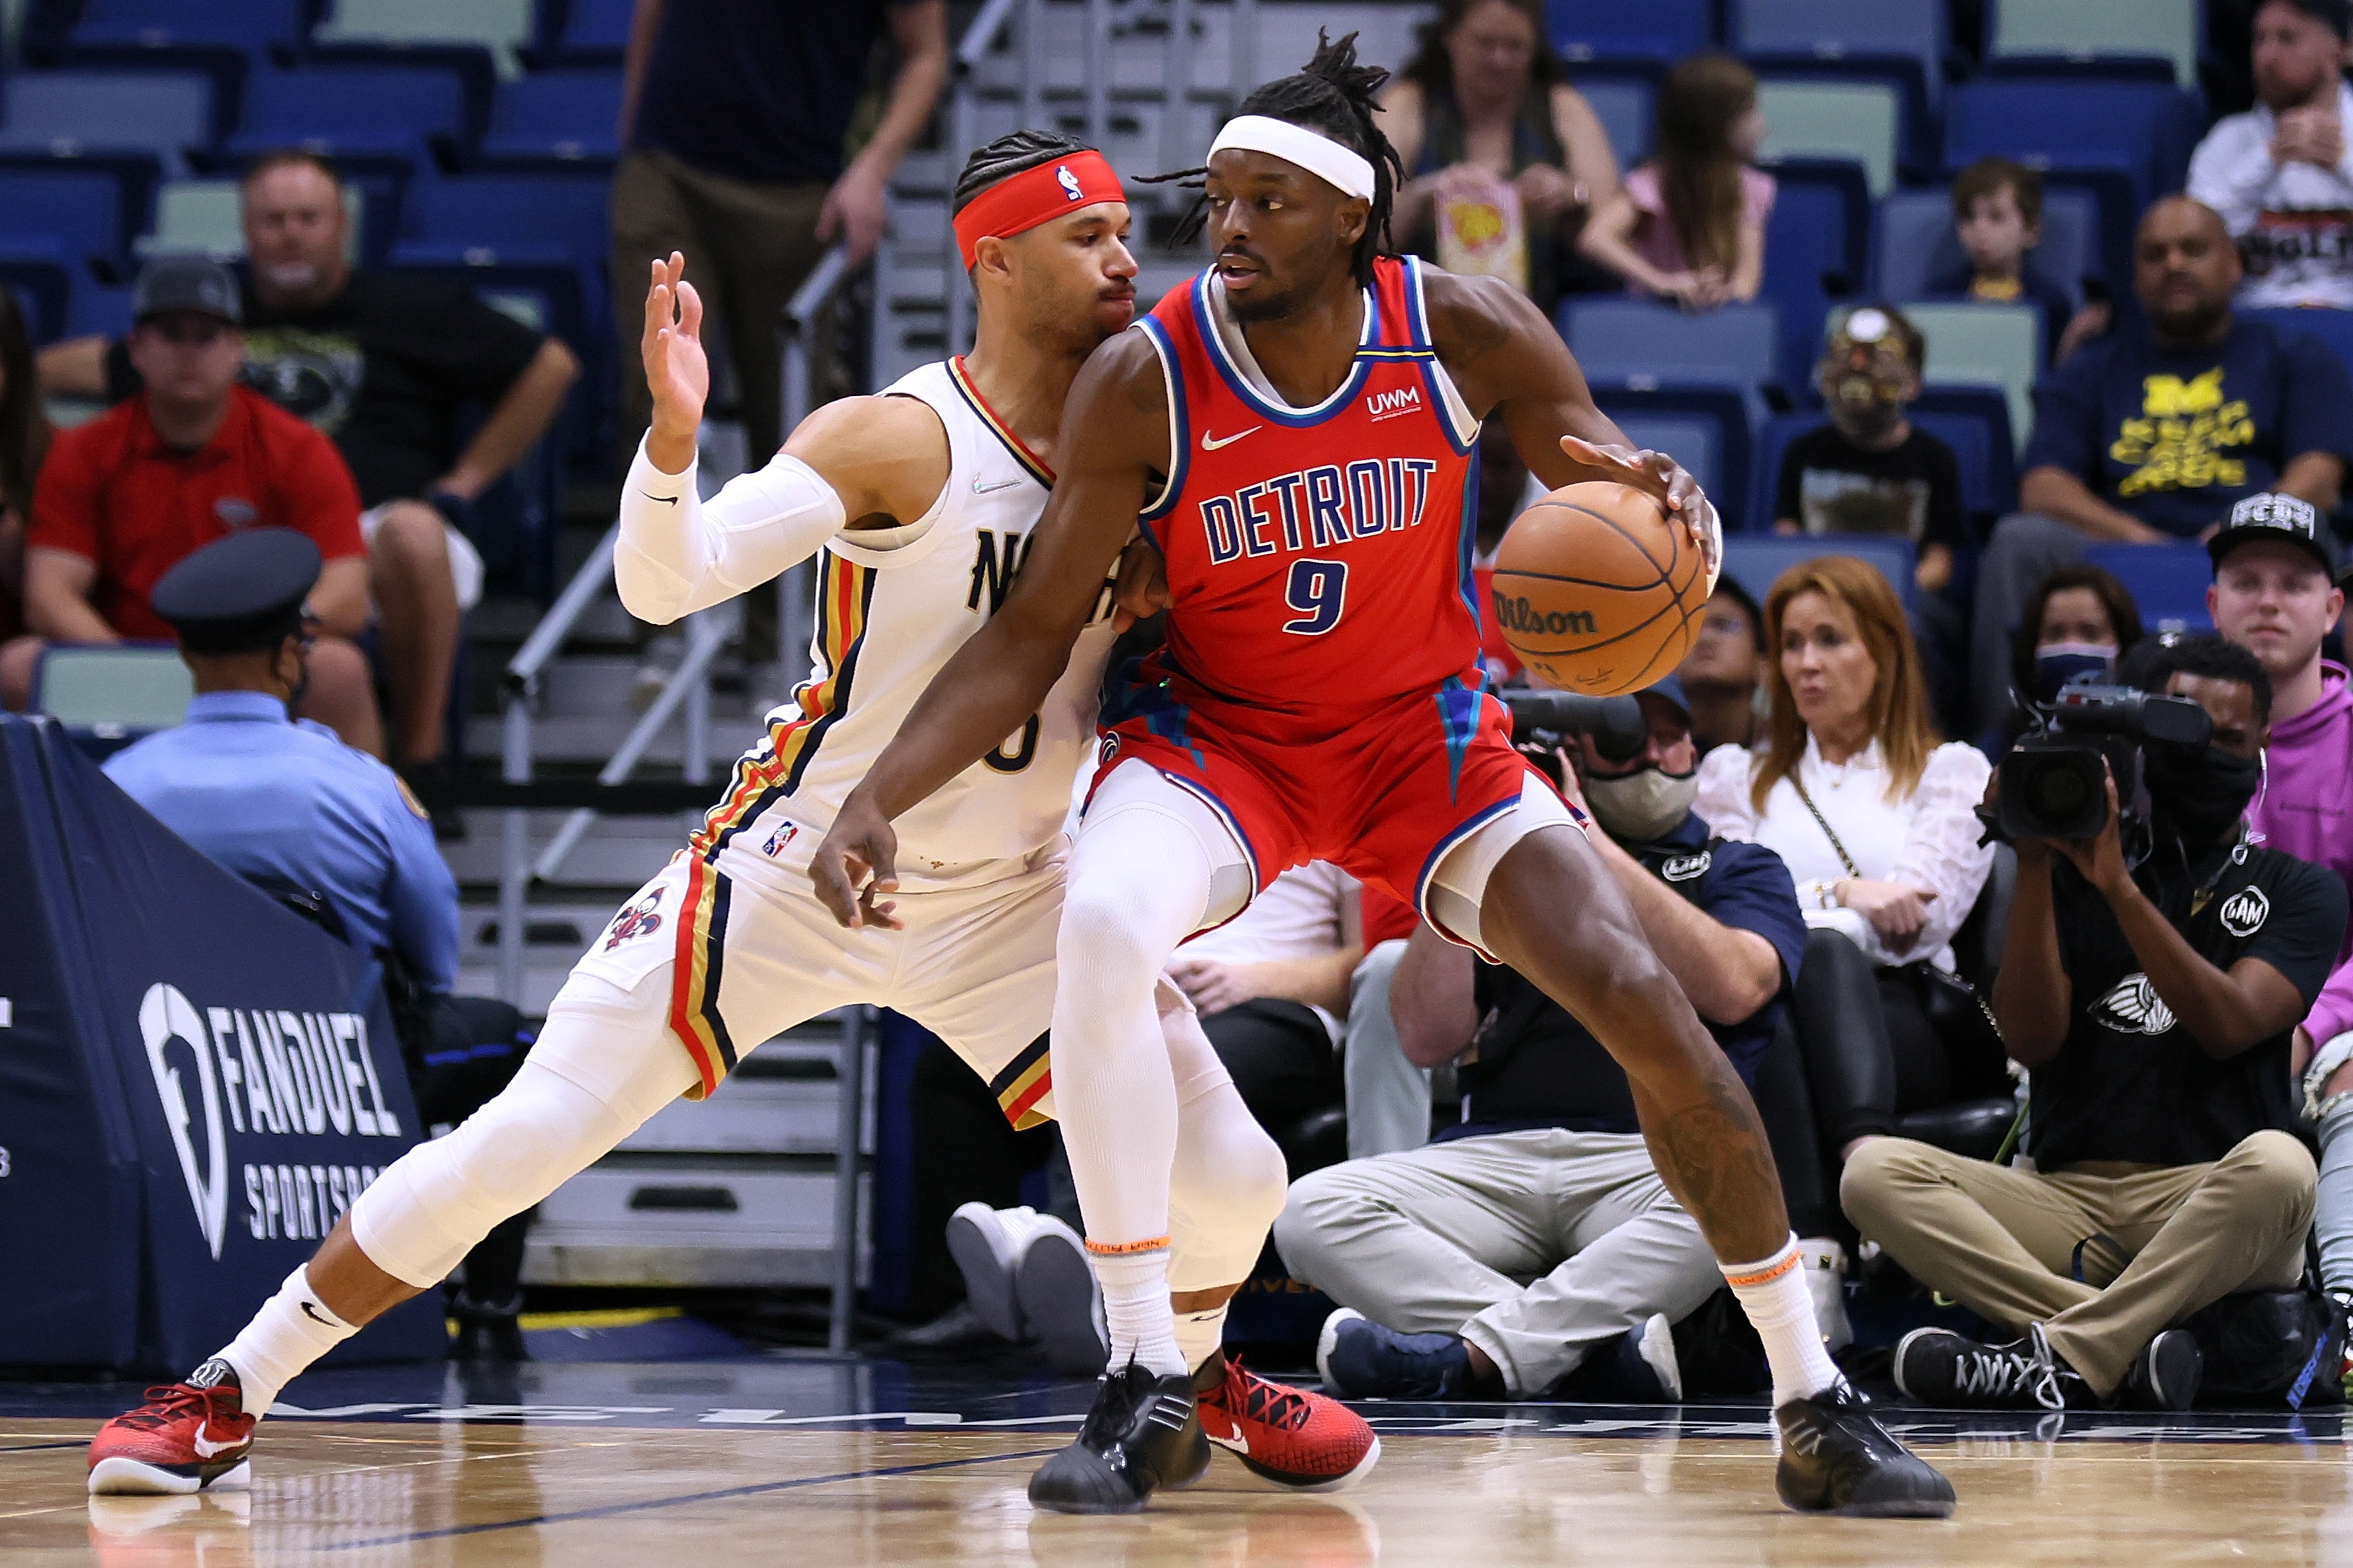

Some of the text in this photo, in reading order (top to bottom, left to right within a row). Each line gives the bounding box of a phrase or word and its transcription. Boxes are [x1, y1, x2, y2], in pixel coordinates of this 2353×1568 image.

[1367, 386, 1420, 414] UWM
[1198, 458, 1436, 565] DETROIT
[1282, 559, 1349, 634] 9
[208, 1007, 401, 1136] FANDUEL
[244, 1164, 388, 1240] SPORTSB
